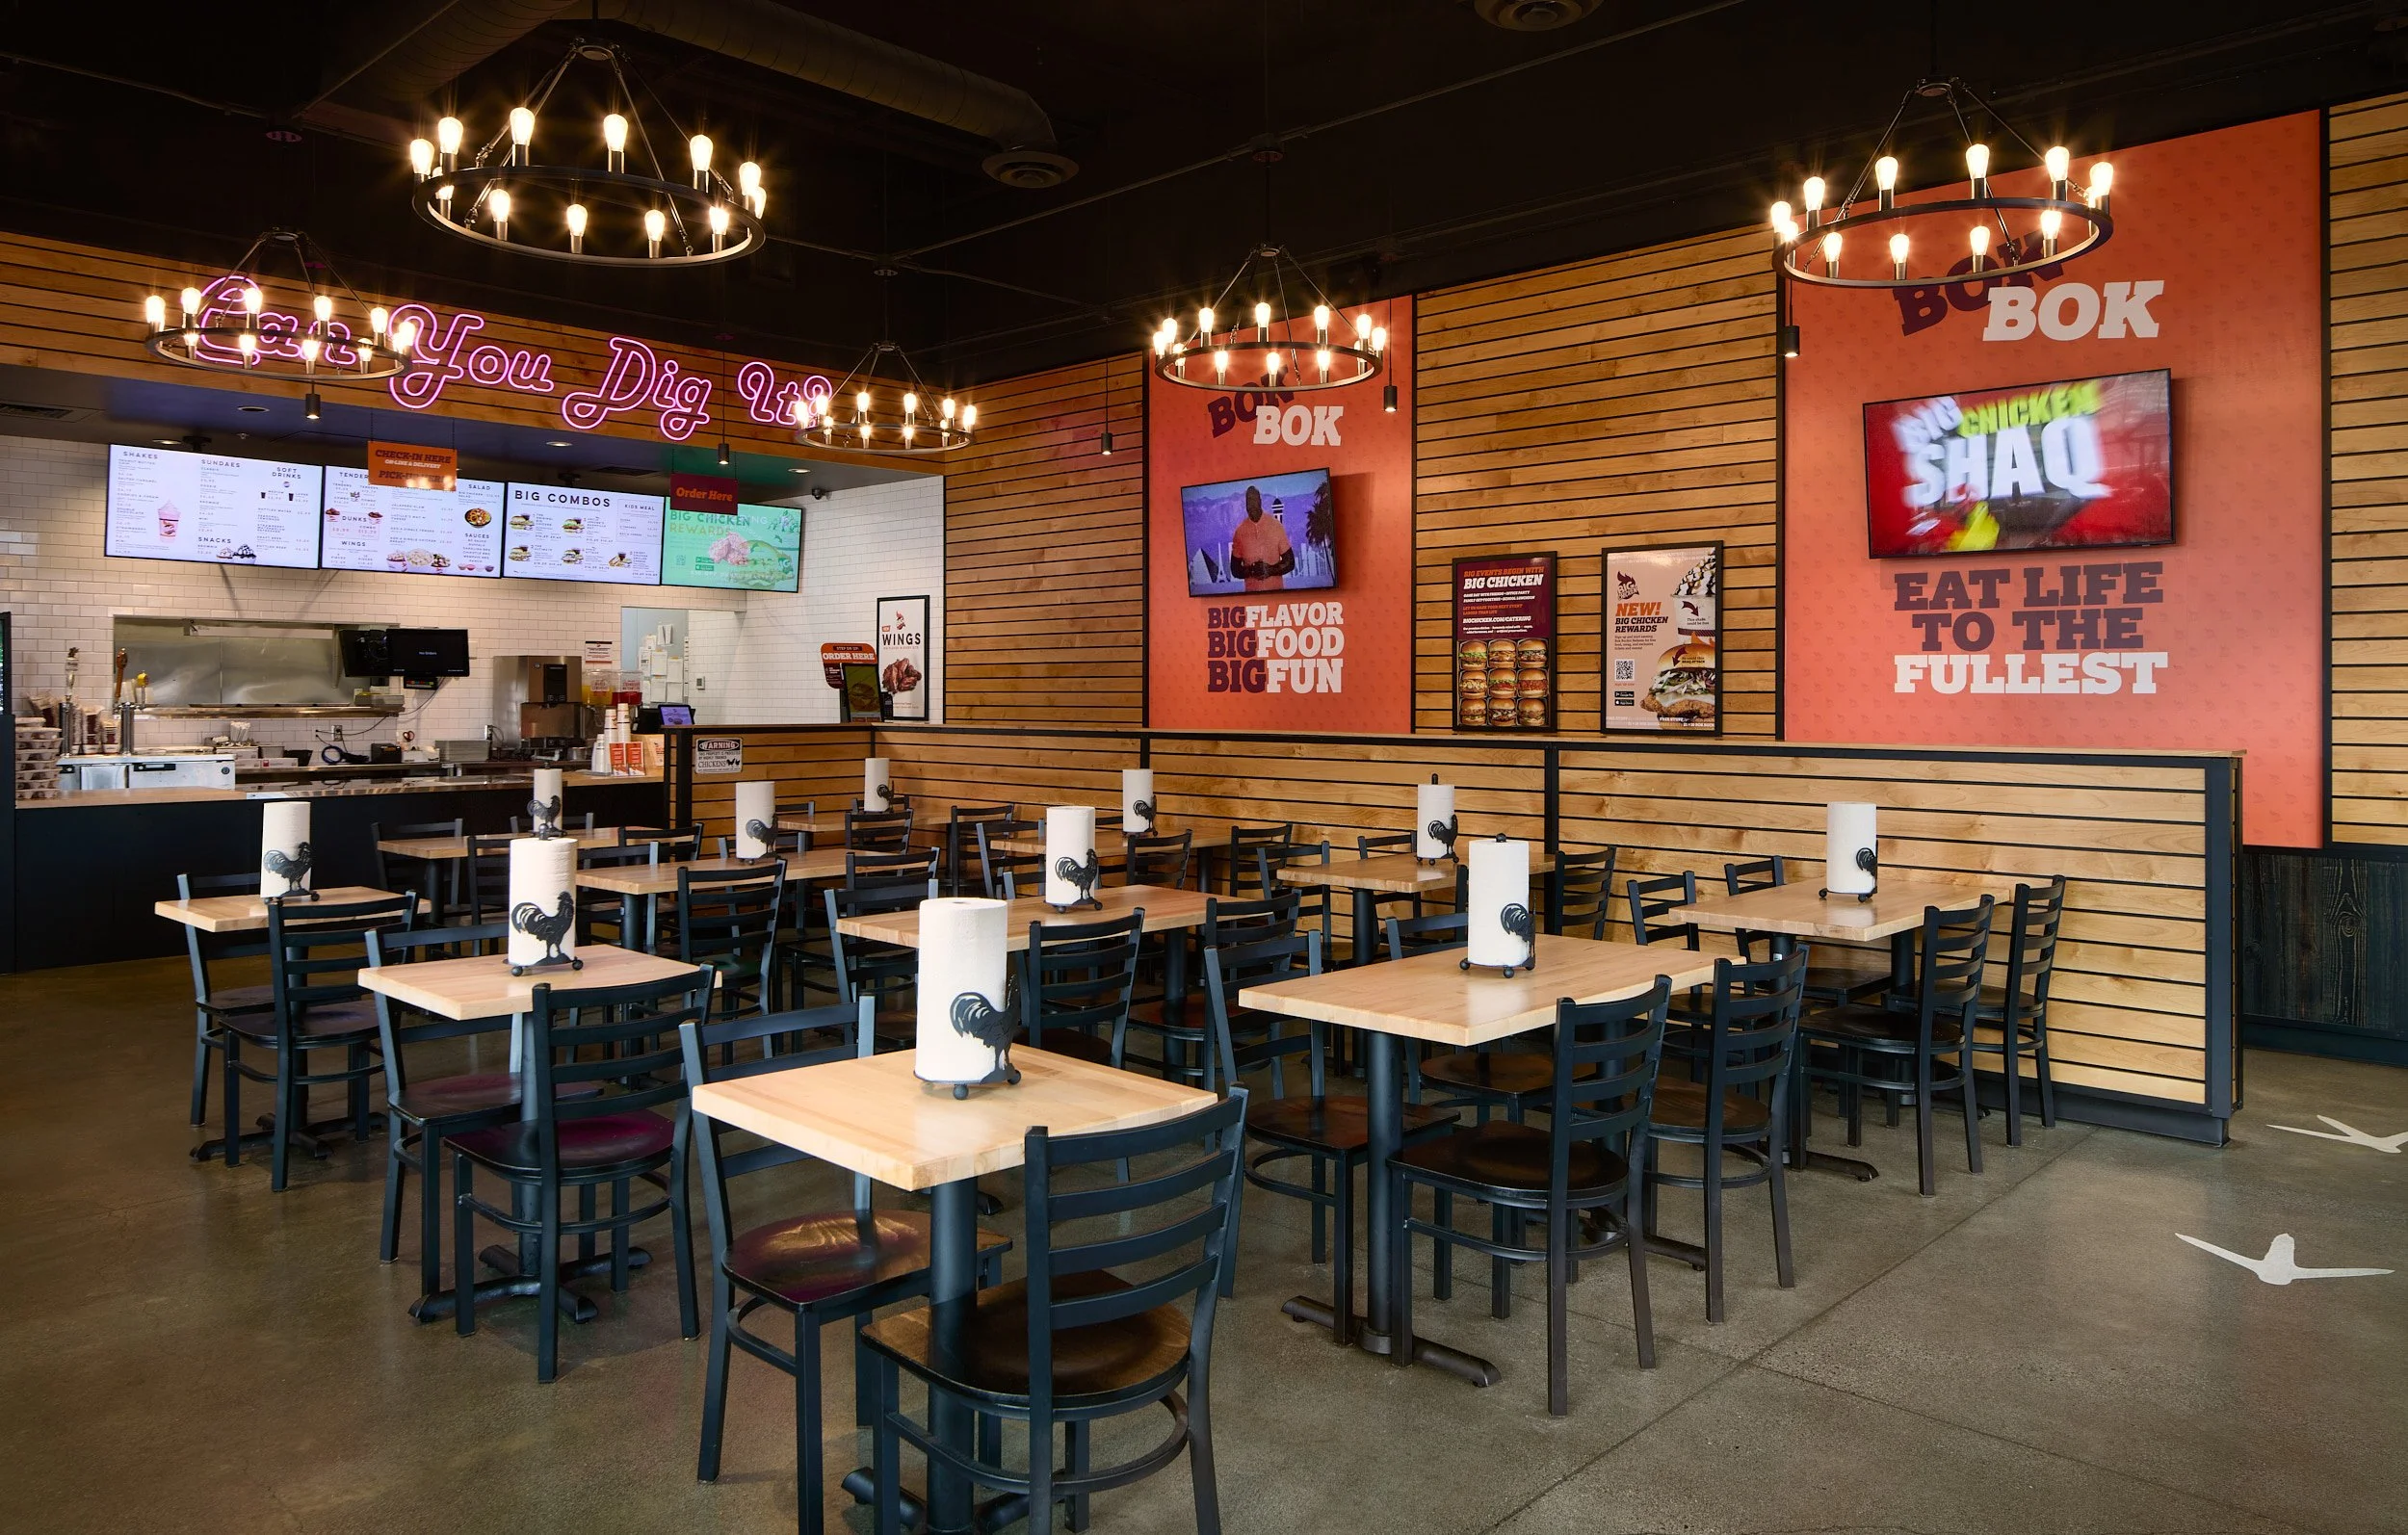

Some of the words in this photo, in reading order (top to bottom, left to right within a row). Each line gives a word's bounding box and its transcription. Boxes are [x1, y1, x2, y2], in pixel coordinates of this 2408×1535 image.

[1893, 229, 2064, 337] BOK
[1982, 280, 2165, 342] BOK
[388, 303, 555, 408] You
[563, 336, 714, 441] Dig
[738, 362, 832, 429] It?
[1207, 364, 1295, 438] BOK
[1958, 379, 2103, 437] CHICKEN
[1253, 404, 1345, 447] BOK
[123, 451, 158, 459] SHAKES
[201, 458, 241, 468] SUNDAES
[376, 449, 423, 461] CHECK-IN
[425, 454, 452, 464] HERE
[1903, 415, 2113, 507] SHAQ
[515, 490, 540, 501] BIG
[548, 493, 611, 507] COMBOS
[676, 487, 707, 500] Order
[709, 491, 733, 503] Here
[670, 511, 692, 522] BIG
[697, 513, 750, 527] CHICKEN
[670, 524, 730, 535] REWARDS
[1503, 567, 1524, 576] BEGIN
[1463, 578, 1485, 589] BIG
[1486, 574, 1544, 588] CHICKEN
[1618, 581, 1635, 593] BIG
[1894, 568, 2010, 611] EAT
[2024, 560, 2163, 607] LIFE
[1615, 602, 1662, 616] NEW!
[1631, 616, 1668, 625] CHICKEN
[1912, 611, 1995, 651] TO
[2012, 607, 2143, 650] THE
[882, 633, 921, 645] WINGS
[1894, 651, 2168, 694] FULLEST
